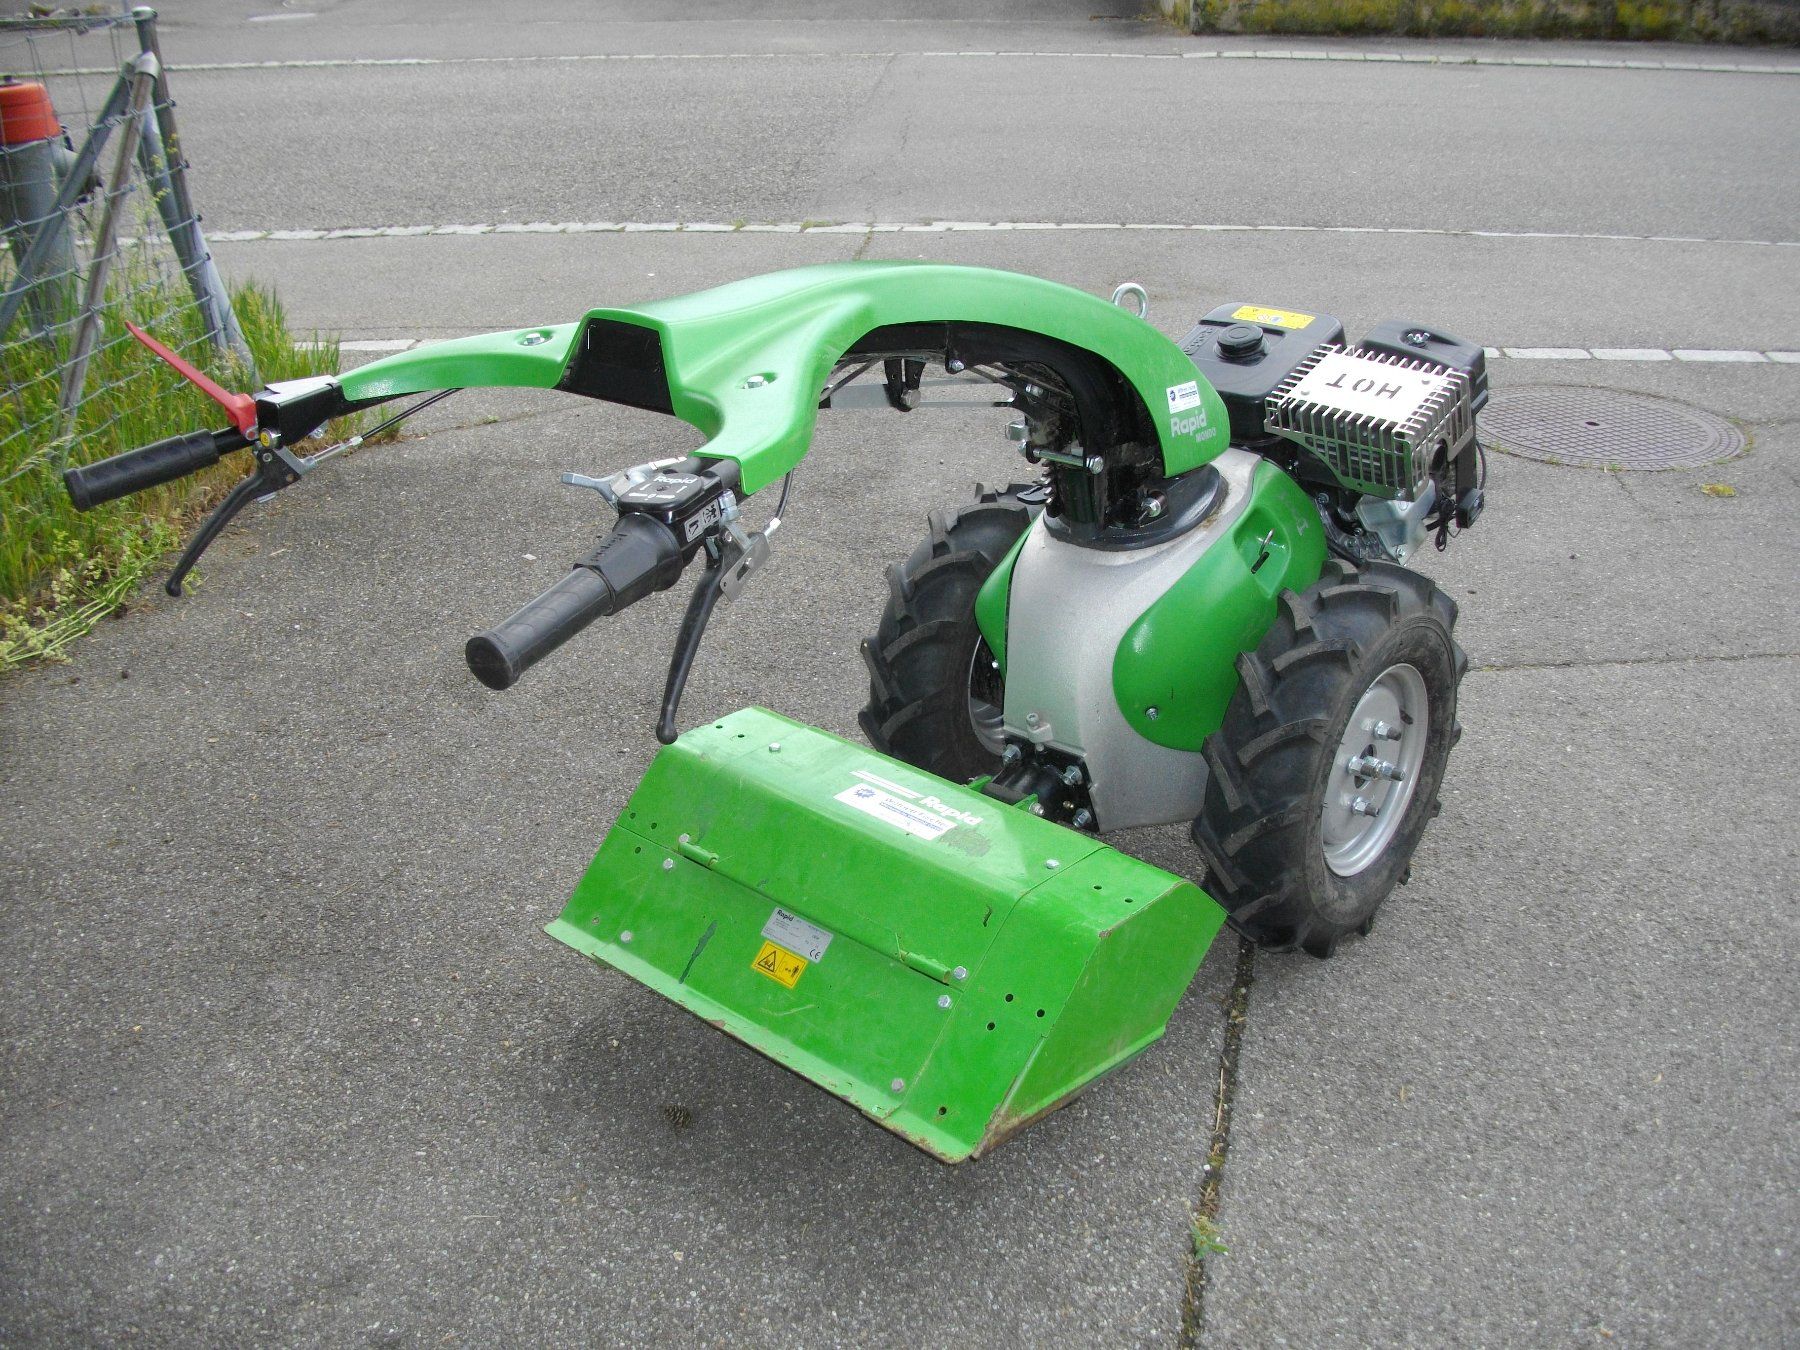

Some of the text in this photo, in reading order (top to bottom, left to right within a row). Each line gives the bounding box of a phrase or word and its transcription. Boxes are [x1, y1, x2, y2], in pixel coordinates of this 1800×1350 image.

[1325, 373, 1402, 399] HOT
[1170, 408, 1207, 438] Rapid
[653, 476, 697, 484] Rapid
[919, 796, 984, 825] Rapid
[776, 909, 795, 922] Rapid
